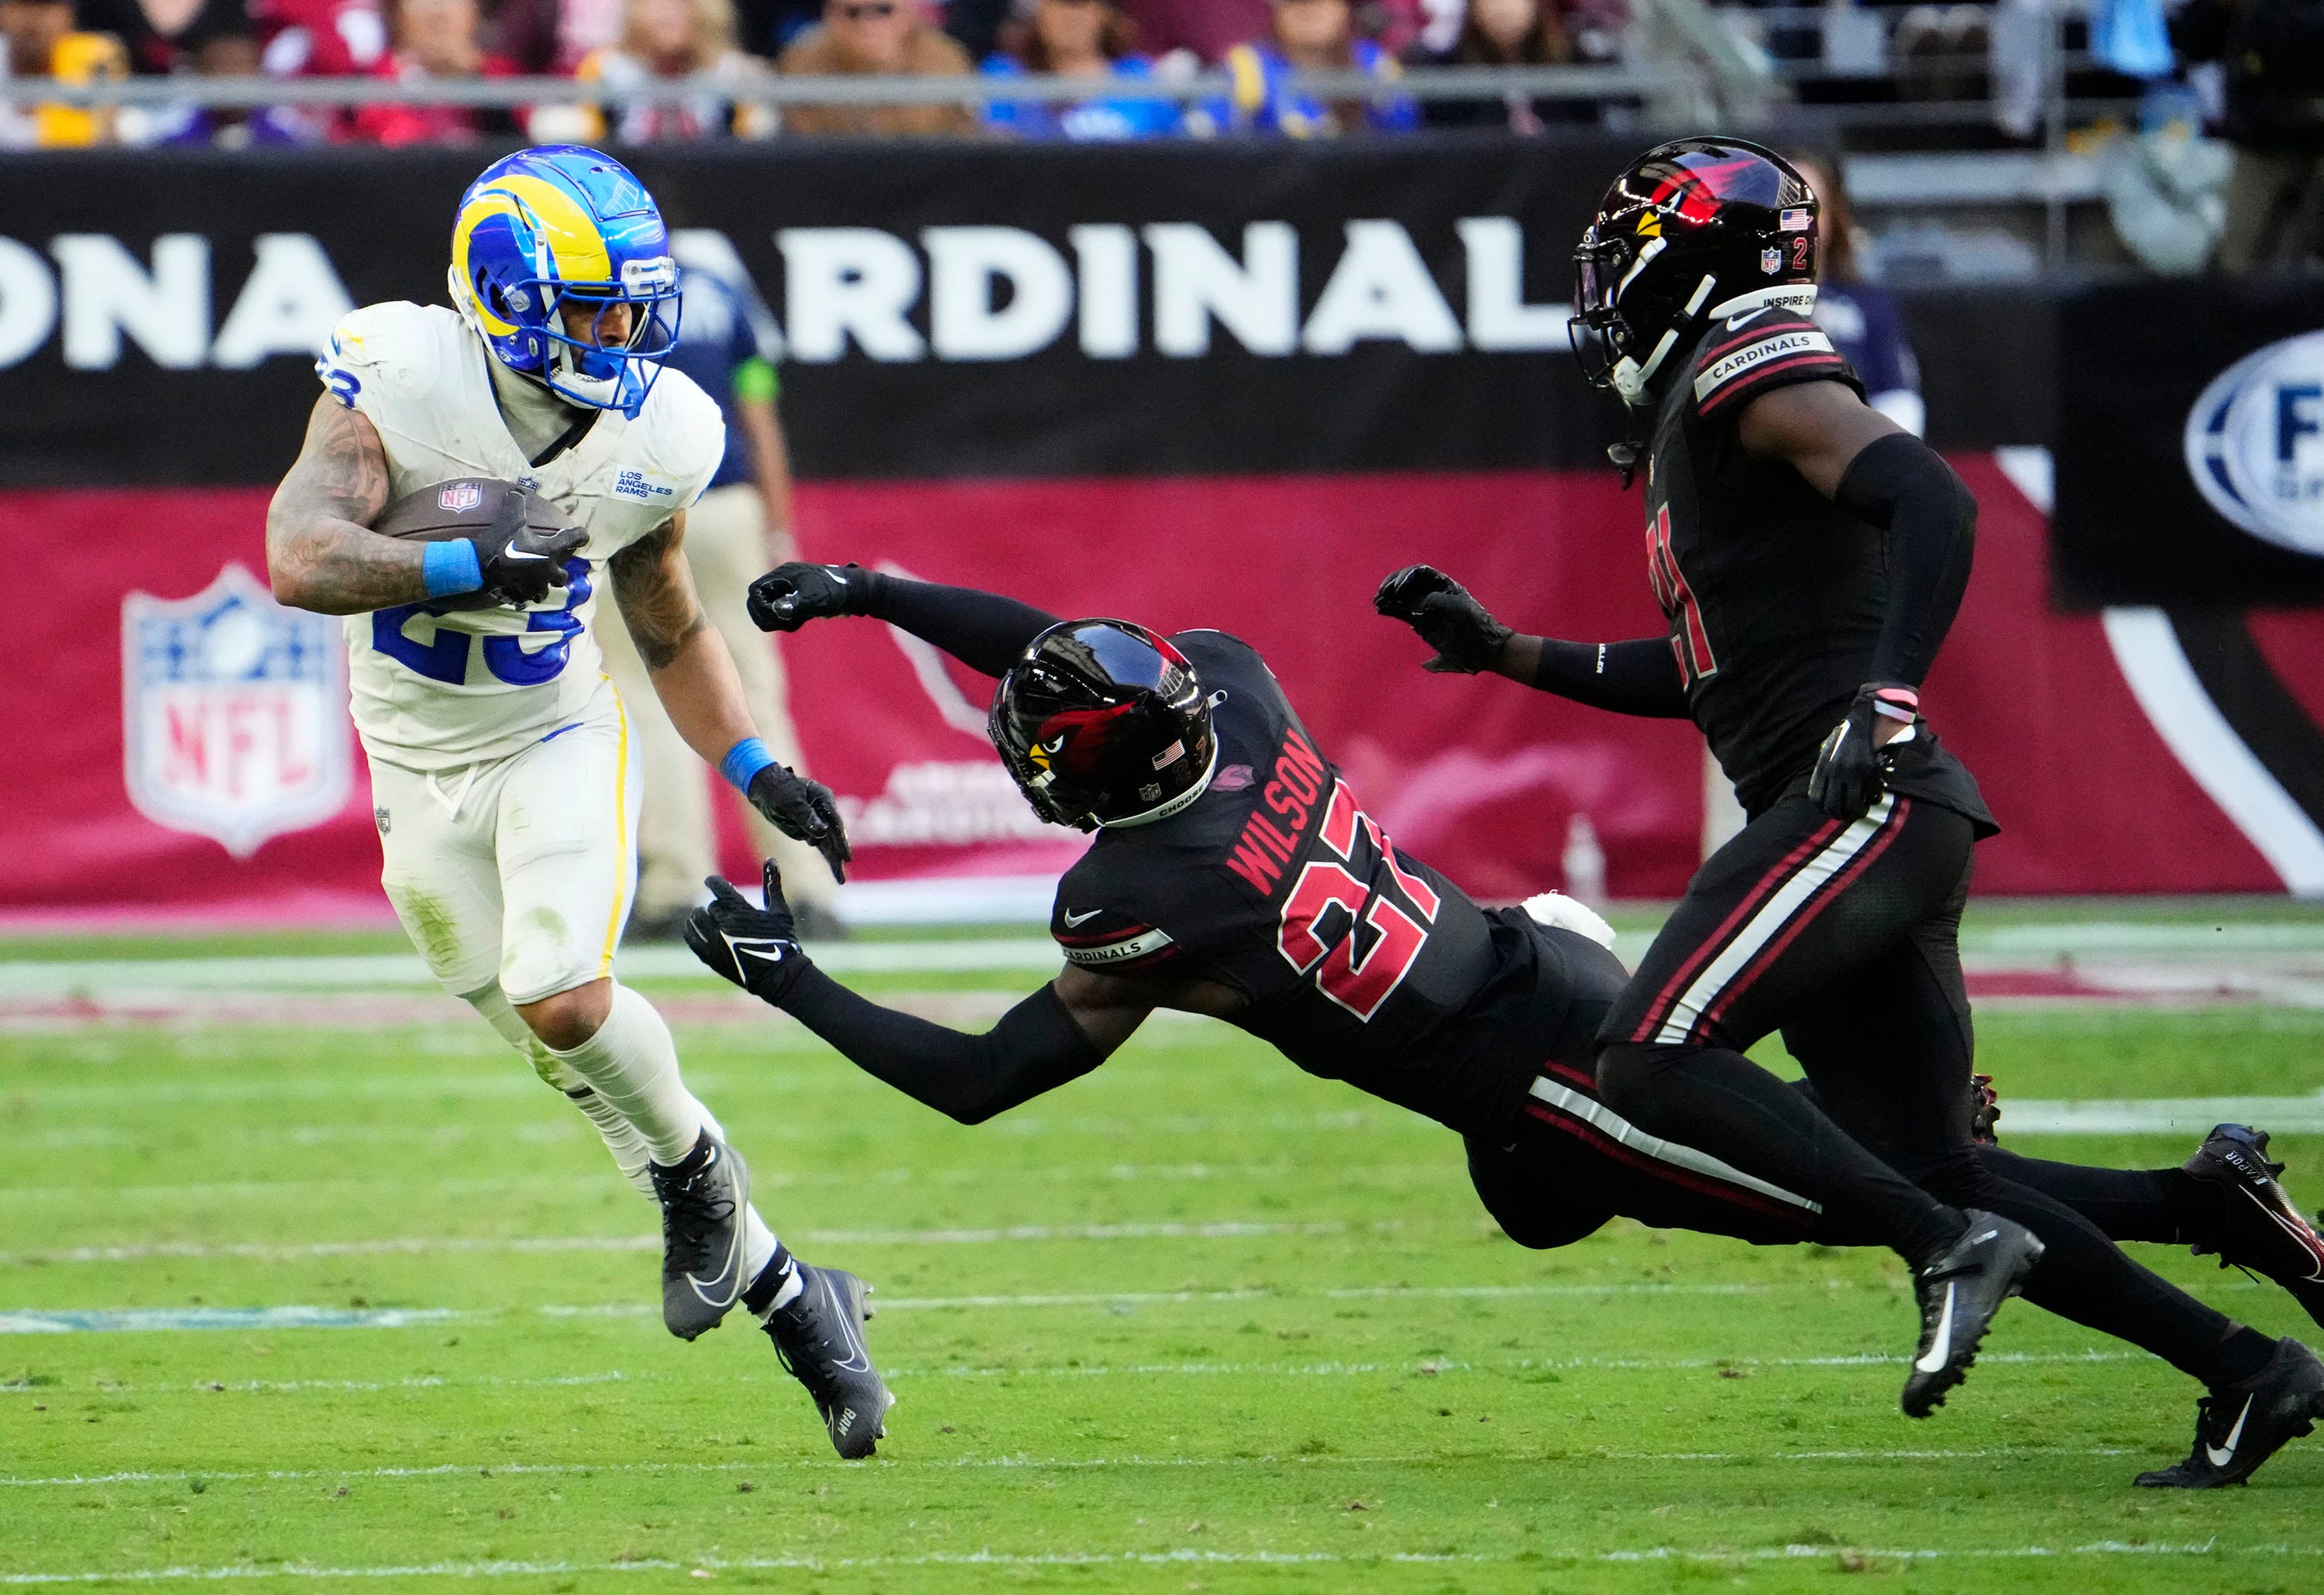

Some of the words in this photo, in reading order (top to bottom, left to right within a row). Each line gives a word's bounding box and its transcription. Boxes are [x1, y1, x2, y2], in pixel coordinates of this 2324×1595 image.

[669, 218, 1604, 363] ARDINAL
[1764, 295, 1803, 308] INSPIRE
[1713, 336, 1810, 379] CARDINALS
[615, 485, 648, 498] RAMS
[617, 478, 673, 496] ANGELES
[620, 470, 643, 480] LOS
[442, 490, 475, 508] NFL
[372, 555, 593, 686] 23
[162, 692, 316, 798] NFL
[1226, 727, 1325, 896] WILSON
[1277, 777, 1441, 1023] 27
[2225, 1152, 2262, 1184] VAPOR
